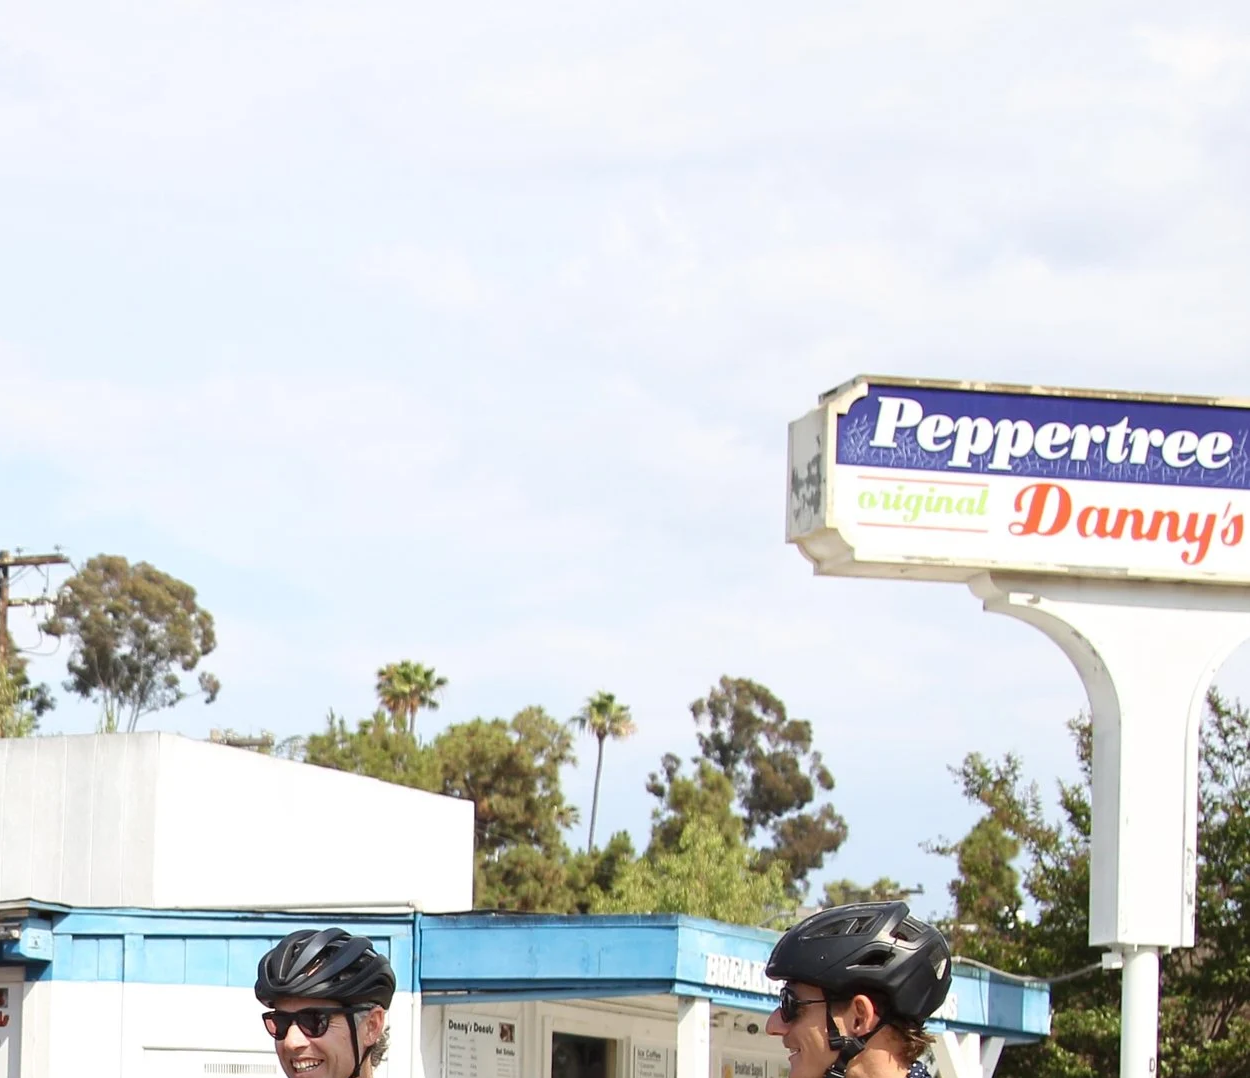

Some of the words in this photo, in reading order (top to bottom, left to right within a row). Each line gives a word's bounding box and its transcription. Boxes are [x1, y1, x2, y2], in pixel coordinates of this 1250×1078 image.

[869, 396, 1233, 470] Peppertree
[857, 485, 989, 522] original
[1008, 482, 1244, 565] Danny's
